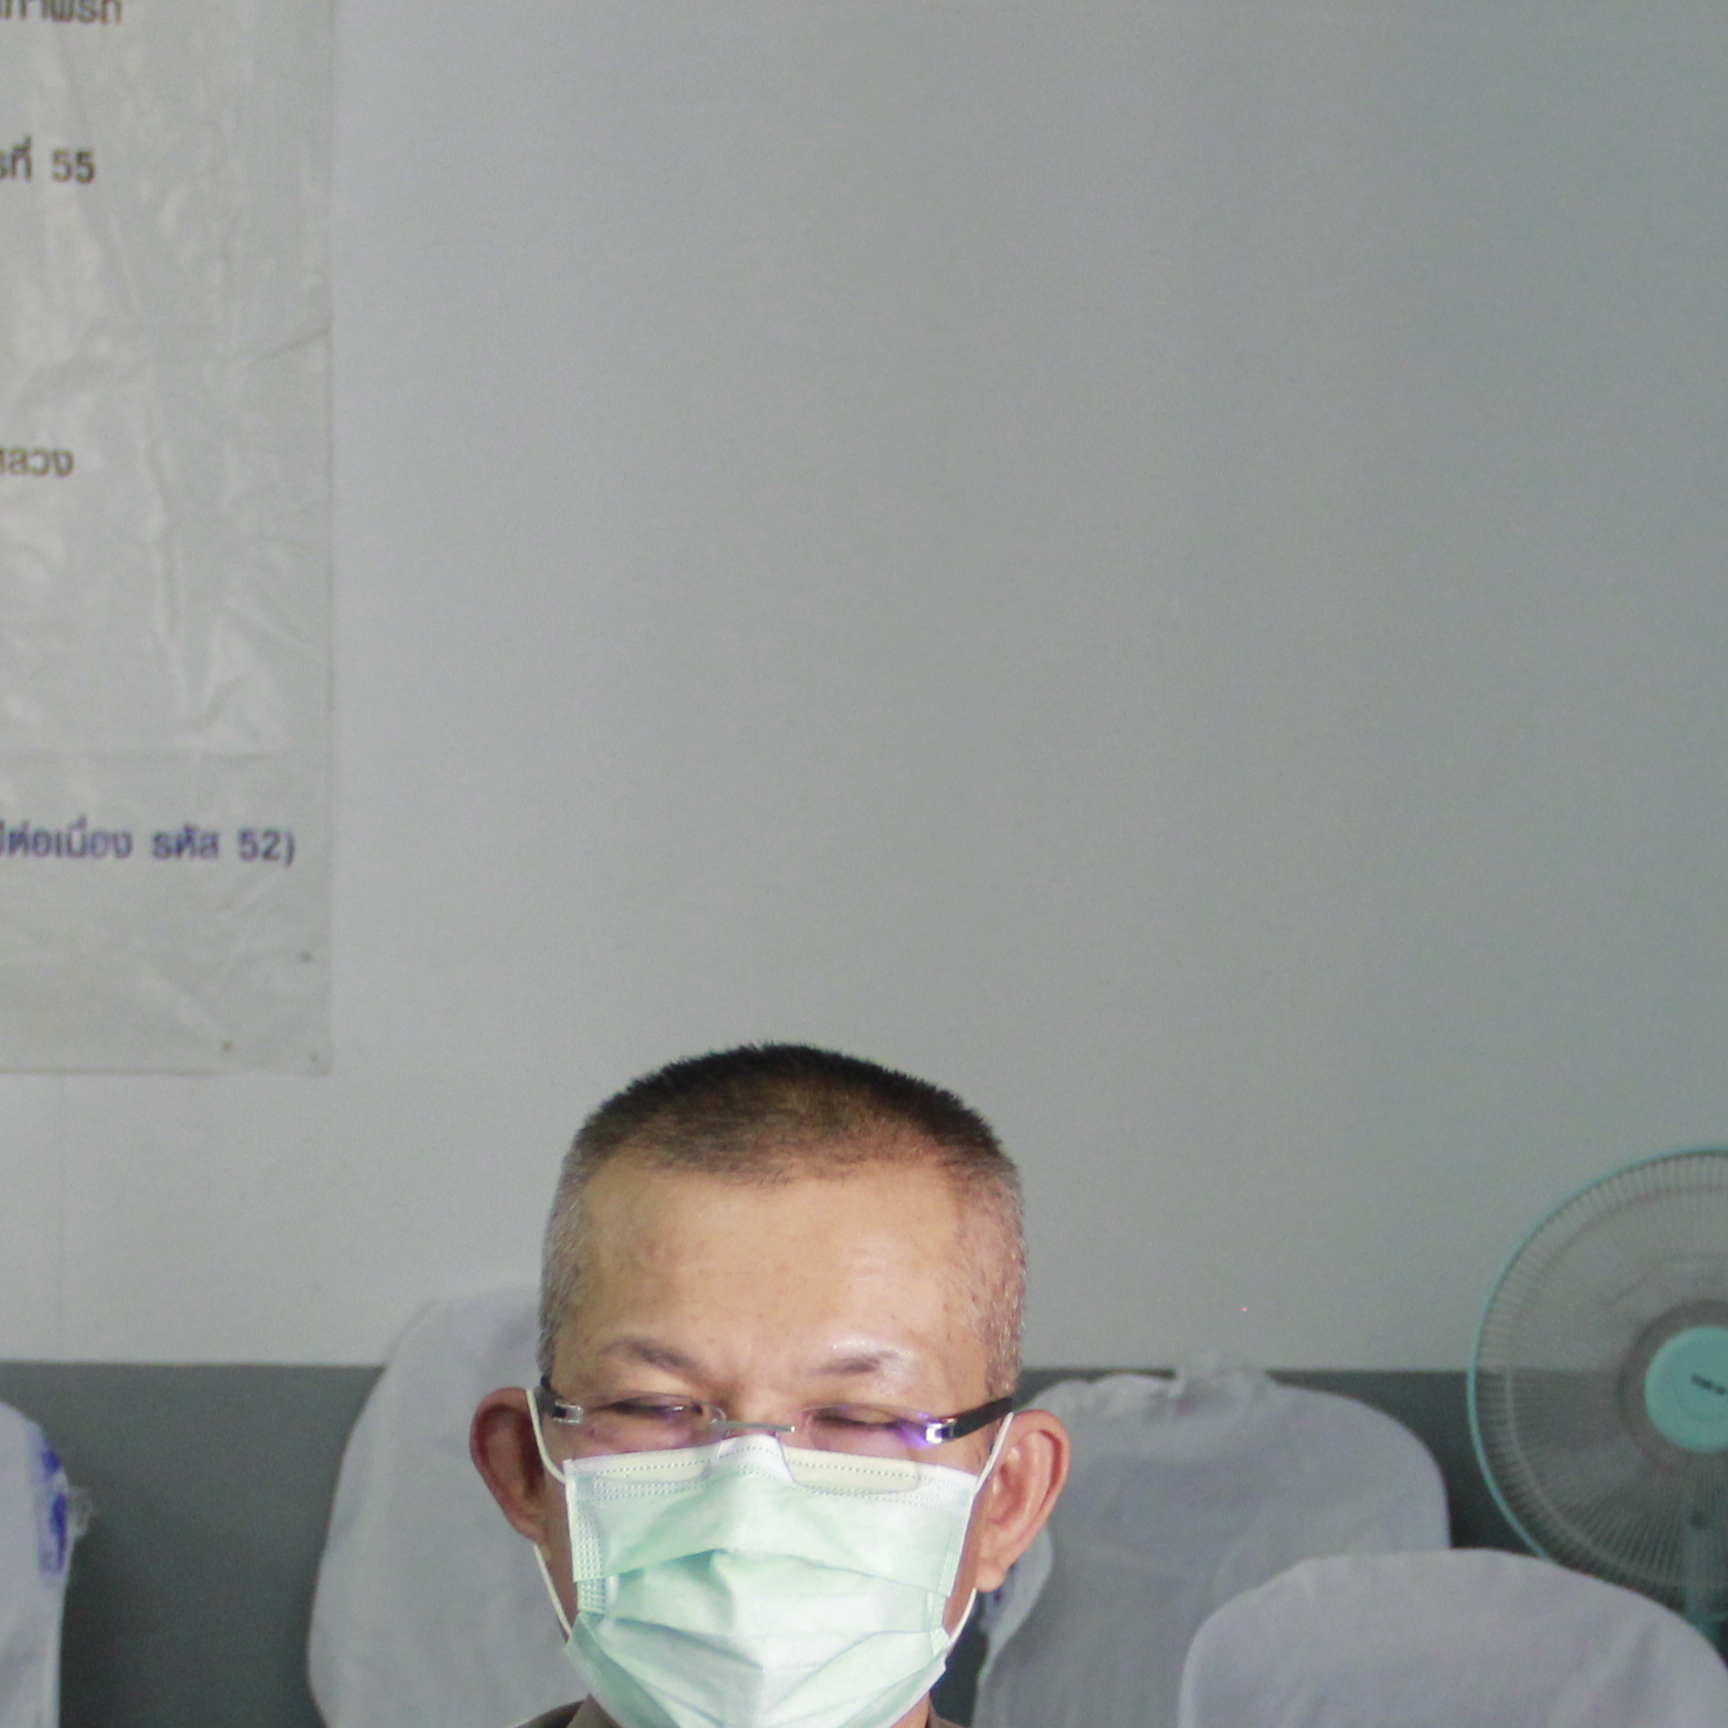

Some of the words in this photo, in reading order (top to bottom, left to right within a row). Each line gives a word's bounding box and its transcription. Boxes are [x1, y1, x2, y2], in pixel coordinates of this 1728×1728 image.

[51, 149, 96, 184] 55
[151, 825, 220, 860] รหัส
[237, 827, 297, 868] 52)
